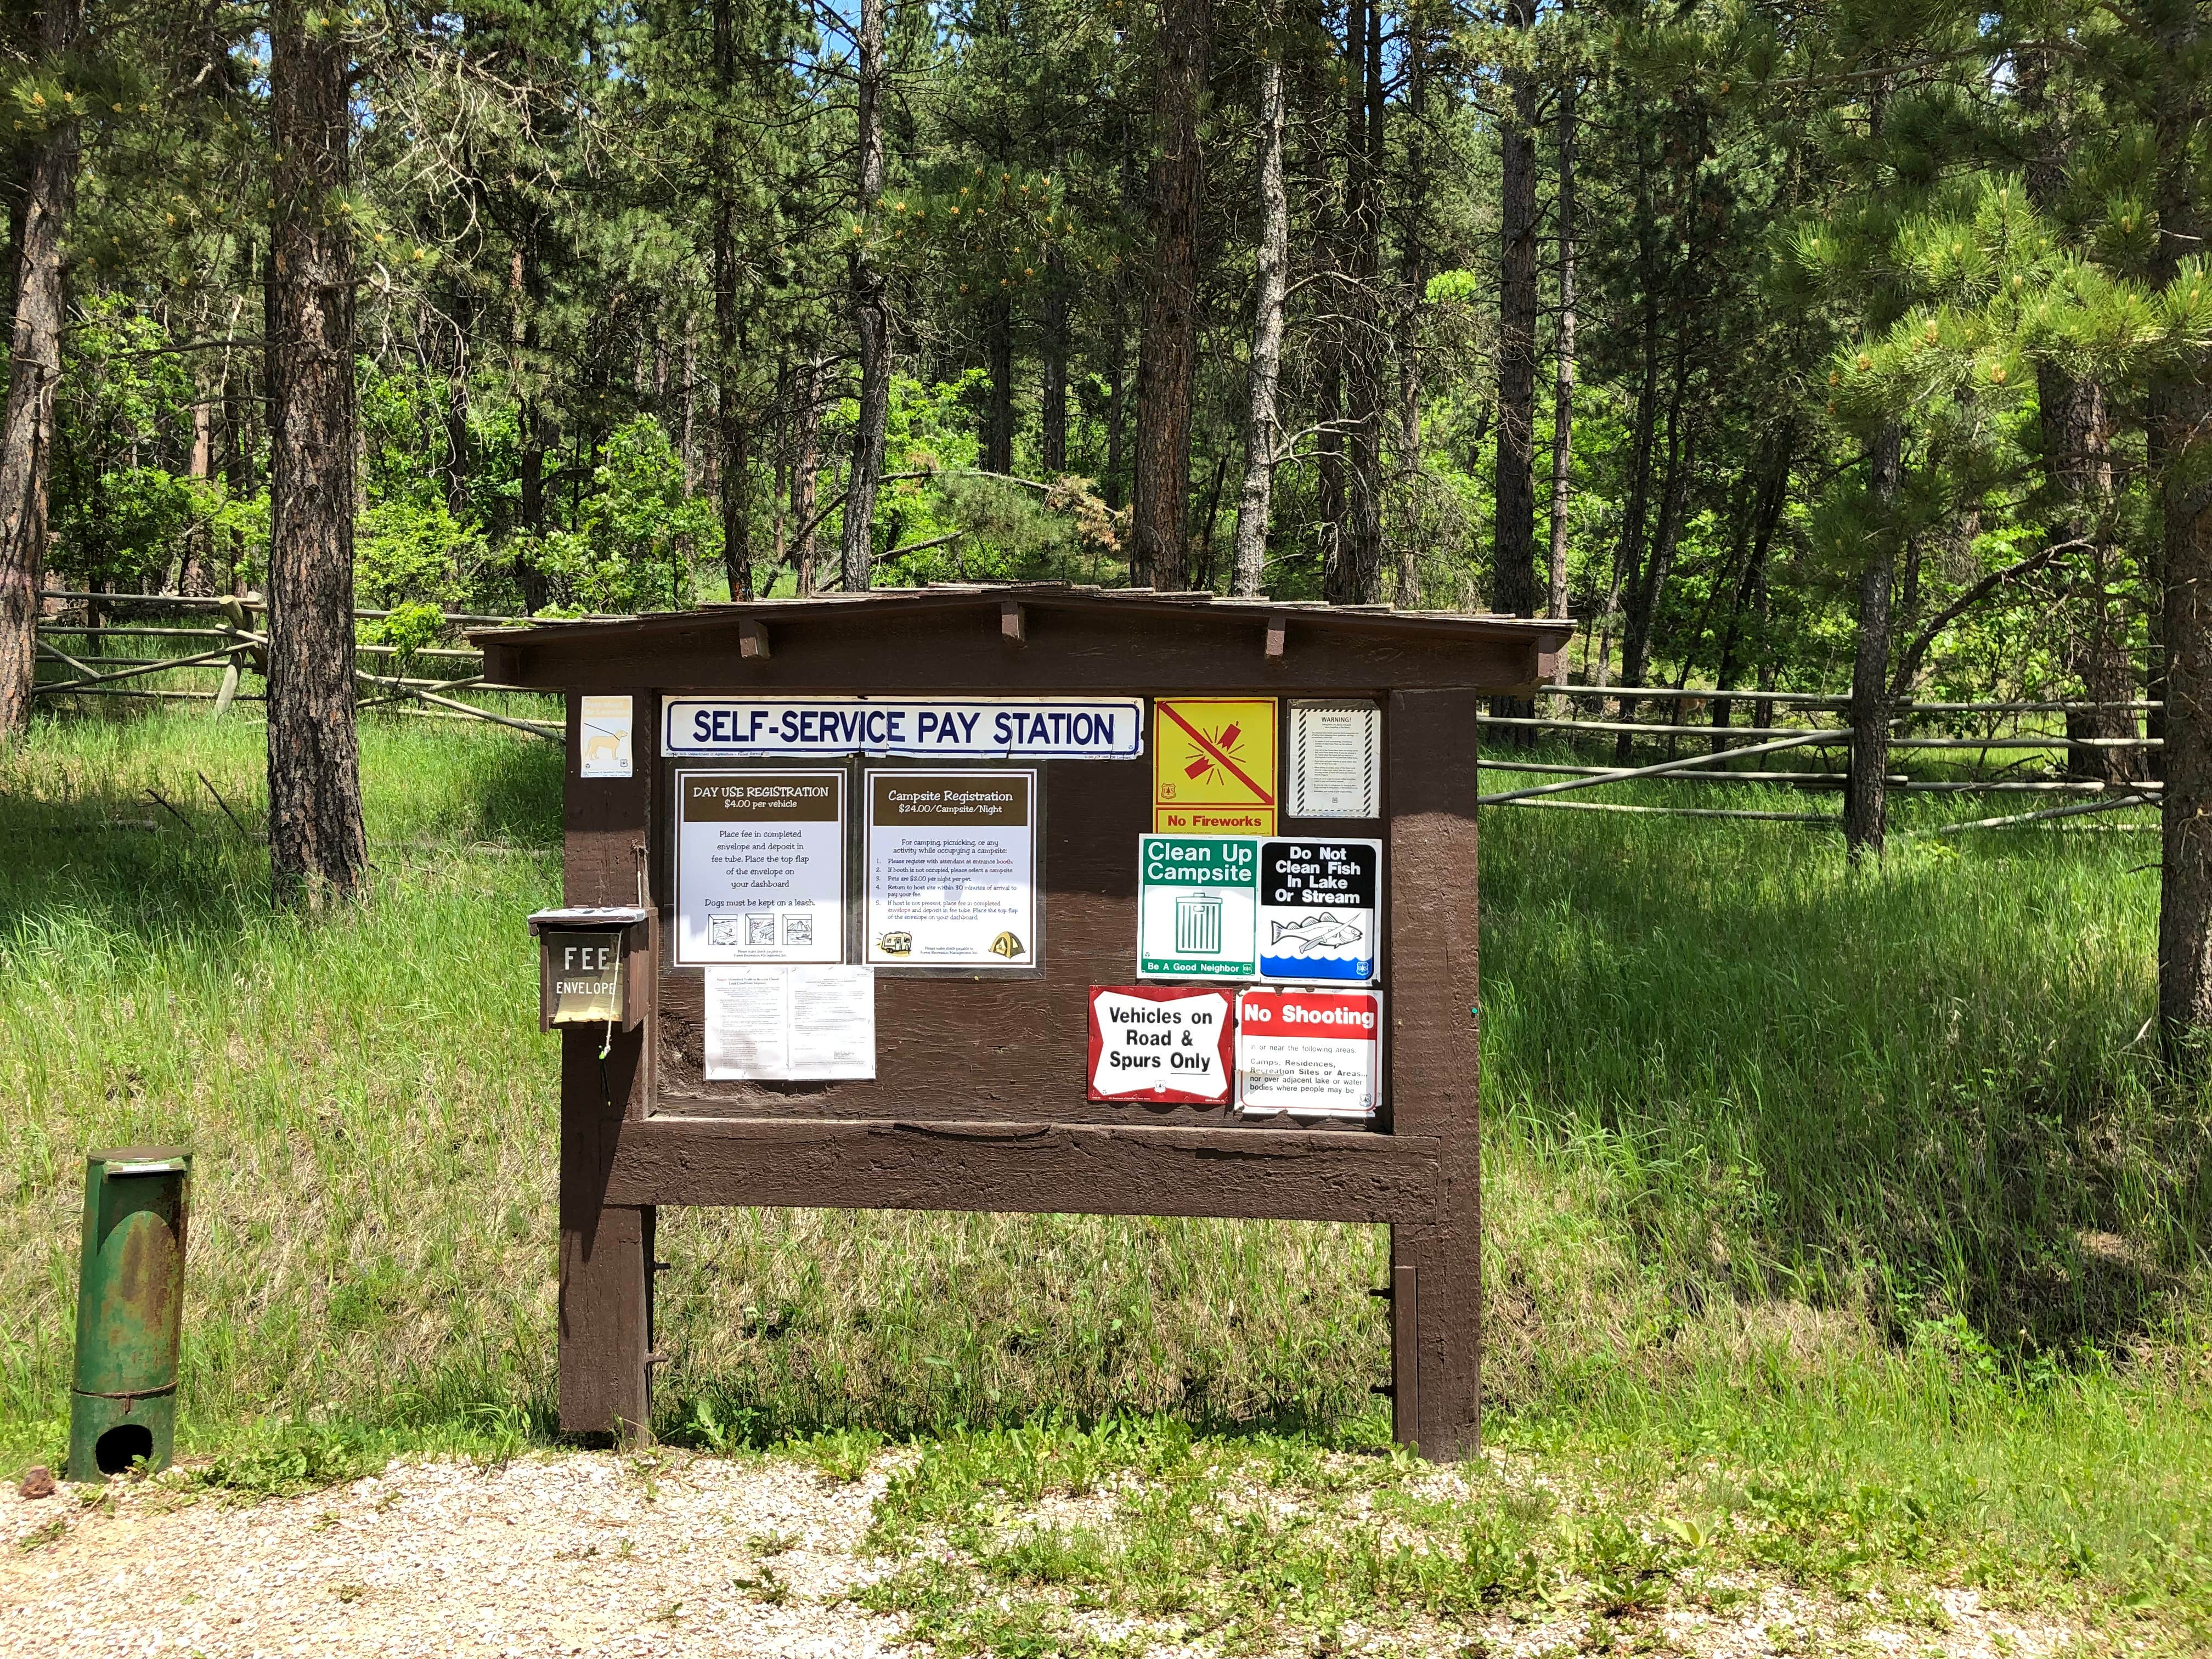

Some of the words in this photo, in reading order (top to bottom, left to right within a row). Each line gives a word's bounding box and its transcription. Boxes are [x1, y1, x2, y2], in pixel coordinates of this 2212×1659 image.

[692, 710, 906, 743] SELF-SERVICE
[918, 712, 981, 743] PAY
[993, 712, 1114, 746] STATION
[693, 787, 719, 798] DAY
[720, 786, 744, 798] USE
[746, 786, 829, 798] REGISTRATION
[888, 789, 941, 804] Campsite
[943, 790, 1013, 804] Registration
[724, 798, 751, 809] $4.00
[752, 801, 766, 810] per
[768, 799, 797, 808] vehicle
[899, 804, 1003, 815] $24.00/Campsite/Night
[1168, 815, 1186, 826] No
[1193, 815, 1261, 826] Fireworks
[741, 830, 753, 838] fee
[763, 830, 802, 840] completed
[716, 843, 751, 853] envelope
[752, 842, 766, 850] and
[768, 842, 795, 852] deposit
[893, 847, 917, 855] activity
[936, 847, 970, 855] occupying
[1147, 842, 1211, 862] Clean
[1222, 843, 1252, 865] Up
[1290, 847, 1312, 860] Do
[1320, 847, 1347, 860] Not
[710, 855, 723, 863] fee
[744, 855, 765, 863] Place
[780, 856, 794, 865] top
[795, 855, 810, 865] flap
[726, 867, 735, 875] of
[750, 867, 783, 877] envelope
[1147, 862, 1252, 883] Campsite
[1276, 860, 1321, 874] Clean
[1328, 861, 1361, 875] Fish
[731, 882, 749, 890] your
[750, 879, 790, 888] dashboard
[1288, 876, 1301, 888] In
[1310, 876, 1348, 889] Lake
[1275, 889, 1294, 902] Or
[1302, 890, 1359, 904] Stream
[704, 899, 725, 909] Dogs
[758, 899, 775, 909] kept
[565, 947, 610, 970] FEE
[1148, 962, 1159, 970] Be
[1173, 963, 1197, 971] Good
[1200, 963, 1239, 973] Neighbor
[556, 981, 614, 995] ENVELOPE
[1110, 1007, 1181, 1024] Vehicles
[1192, 1013, 1212, 1024] on
[1244, 1004, 1272, 1022] No
[1282, 1005, 1374, 1029] Shooting
[1127, 1030, 1171, 1046] Road
[1181, 1030, 1193, 1046] &
[1110, 1051, 1161, 1070] Spurs
[1171, 1052, 1210, 1072] Only
[1285, 1059, 1336, 1068] Residences,
[1282, 1076, 1312, 1084] adjacent
[1250, 1083, 1273, 1091] bodies
